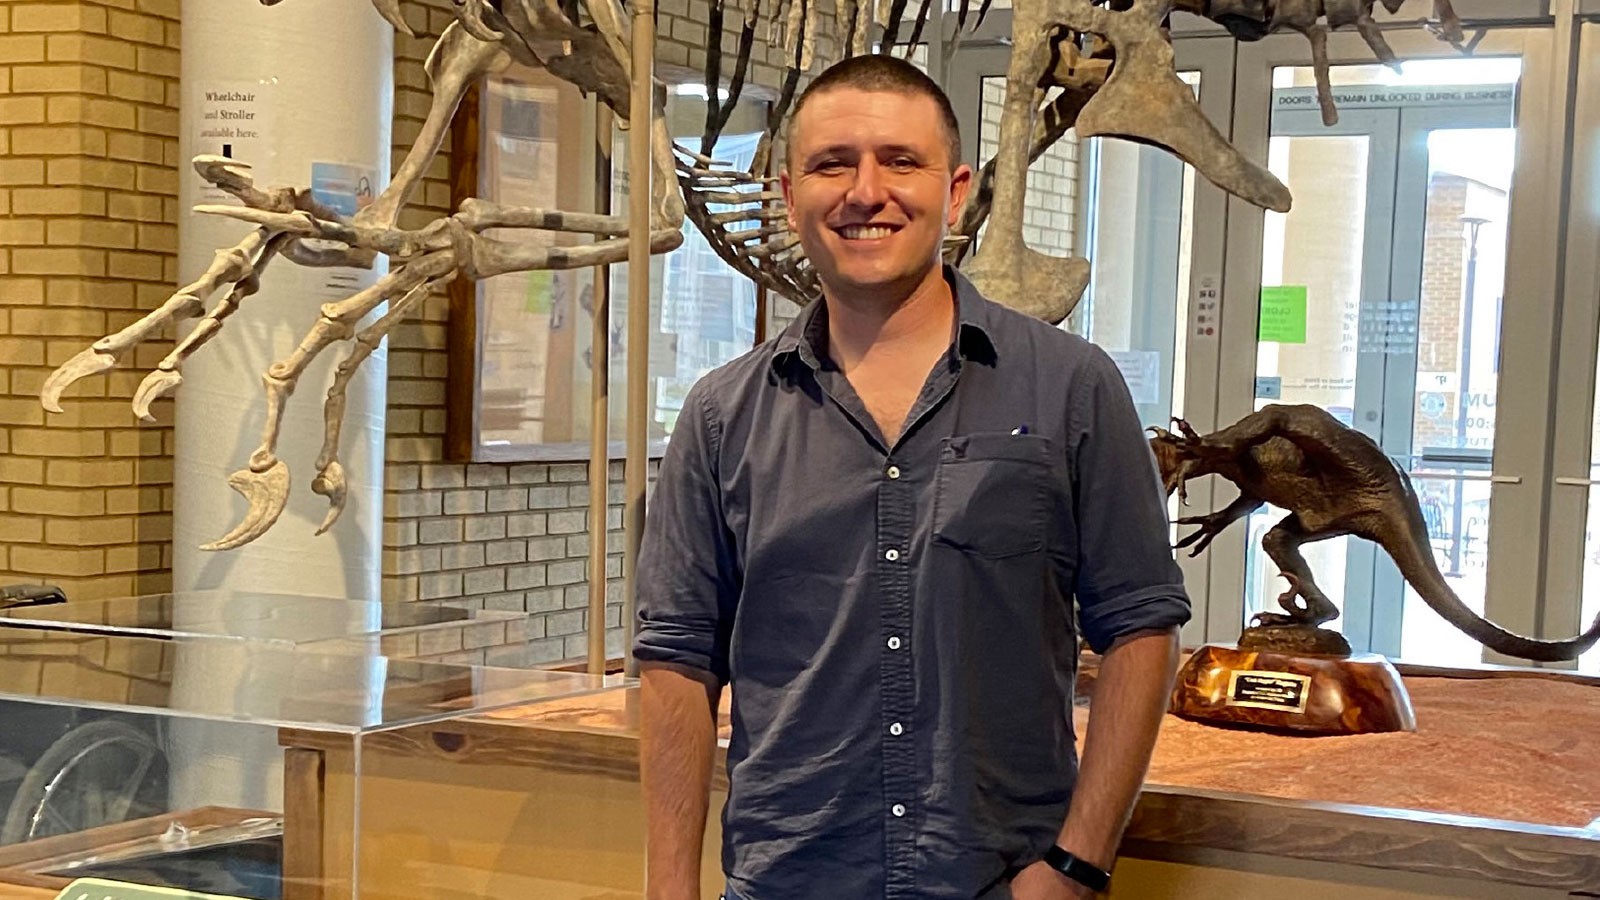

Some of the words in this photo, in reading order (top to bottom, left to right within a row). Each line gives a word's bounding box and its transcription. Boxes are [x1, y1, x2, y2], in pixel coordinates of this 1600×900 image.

[205, 92, 256, 102] Wheelchair
[1278, 96, 1312, 105] DOORS
[1370, 92, 1421, 102] UNLOCKED
[204, 110, 218, 120] and
[220, 109, 256, 120] Stroller
[201, 127, 234, 138] available
